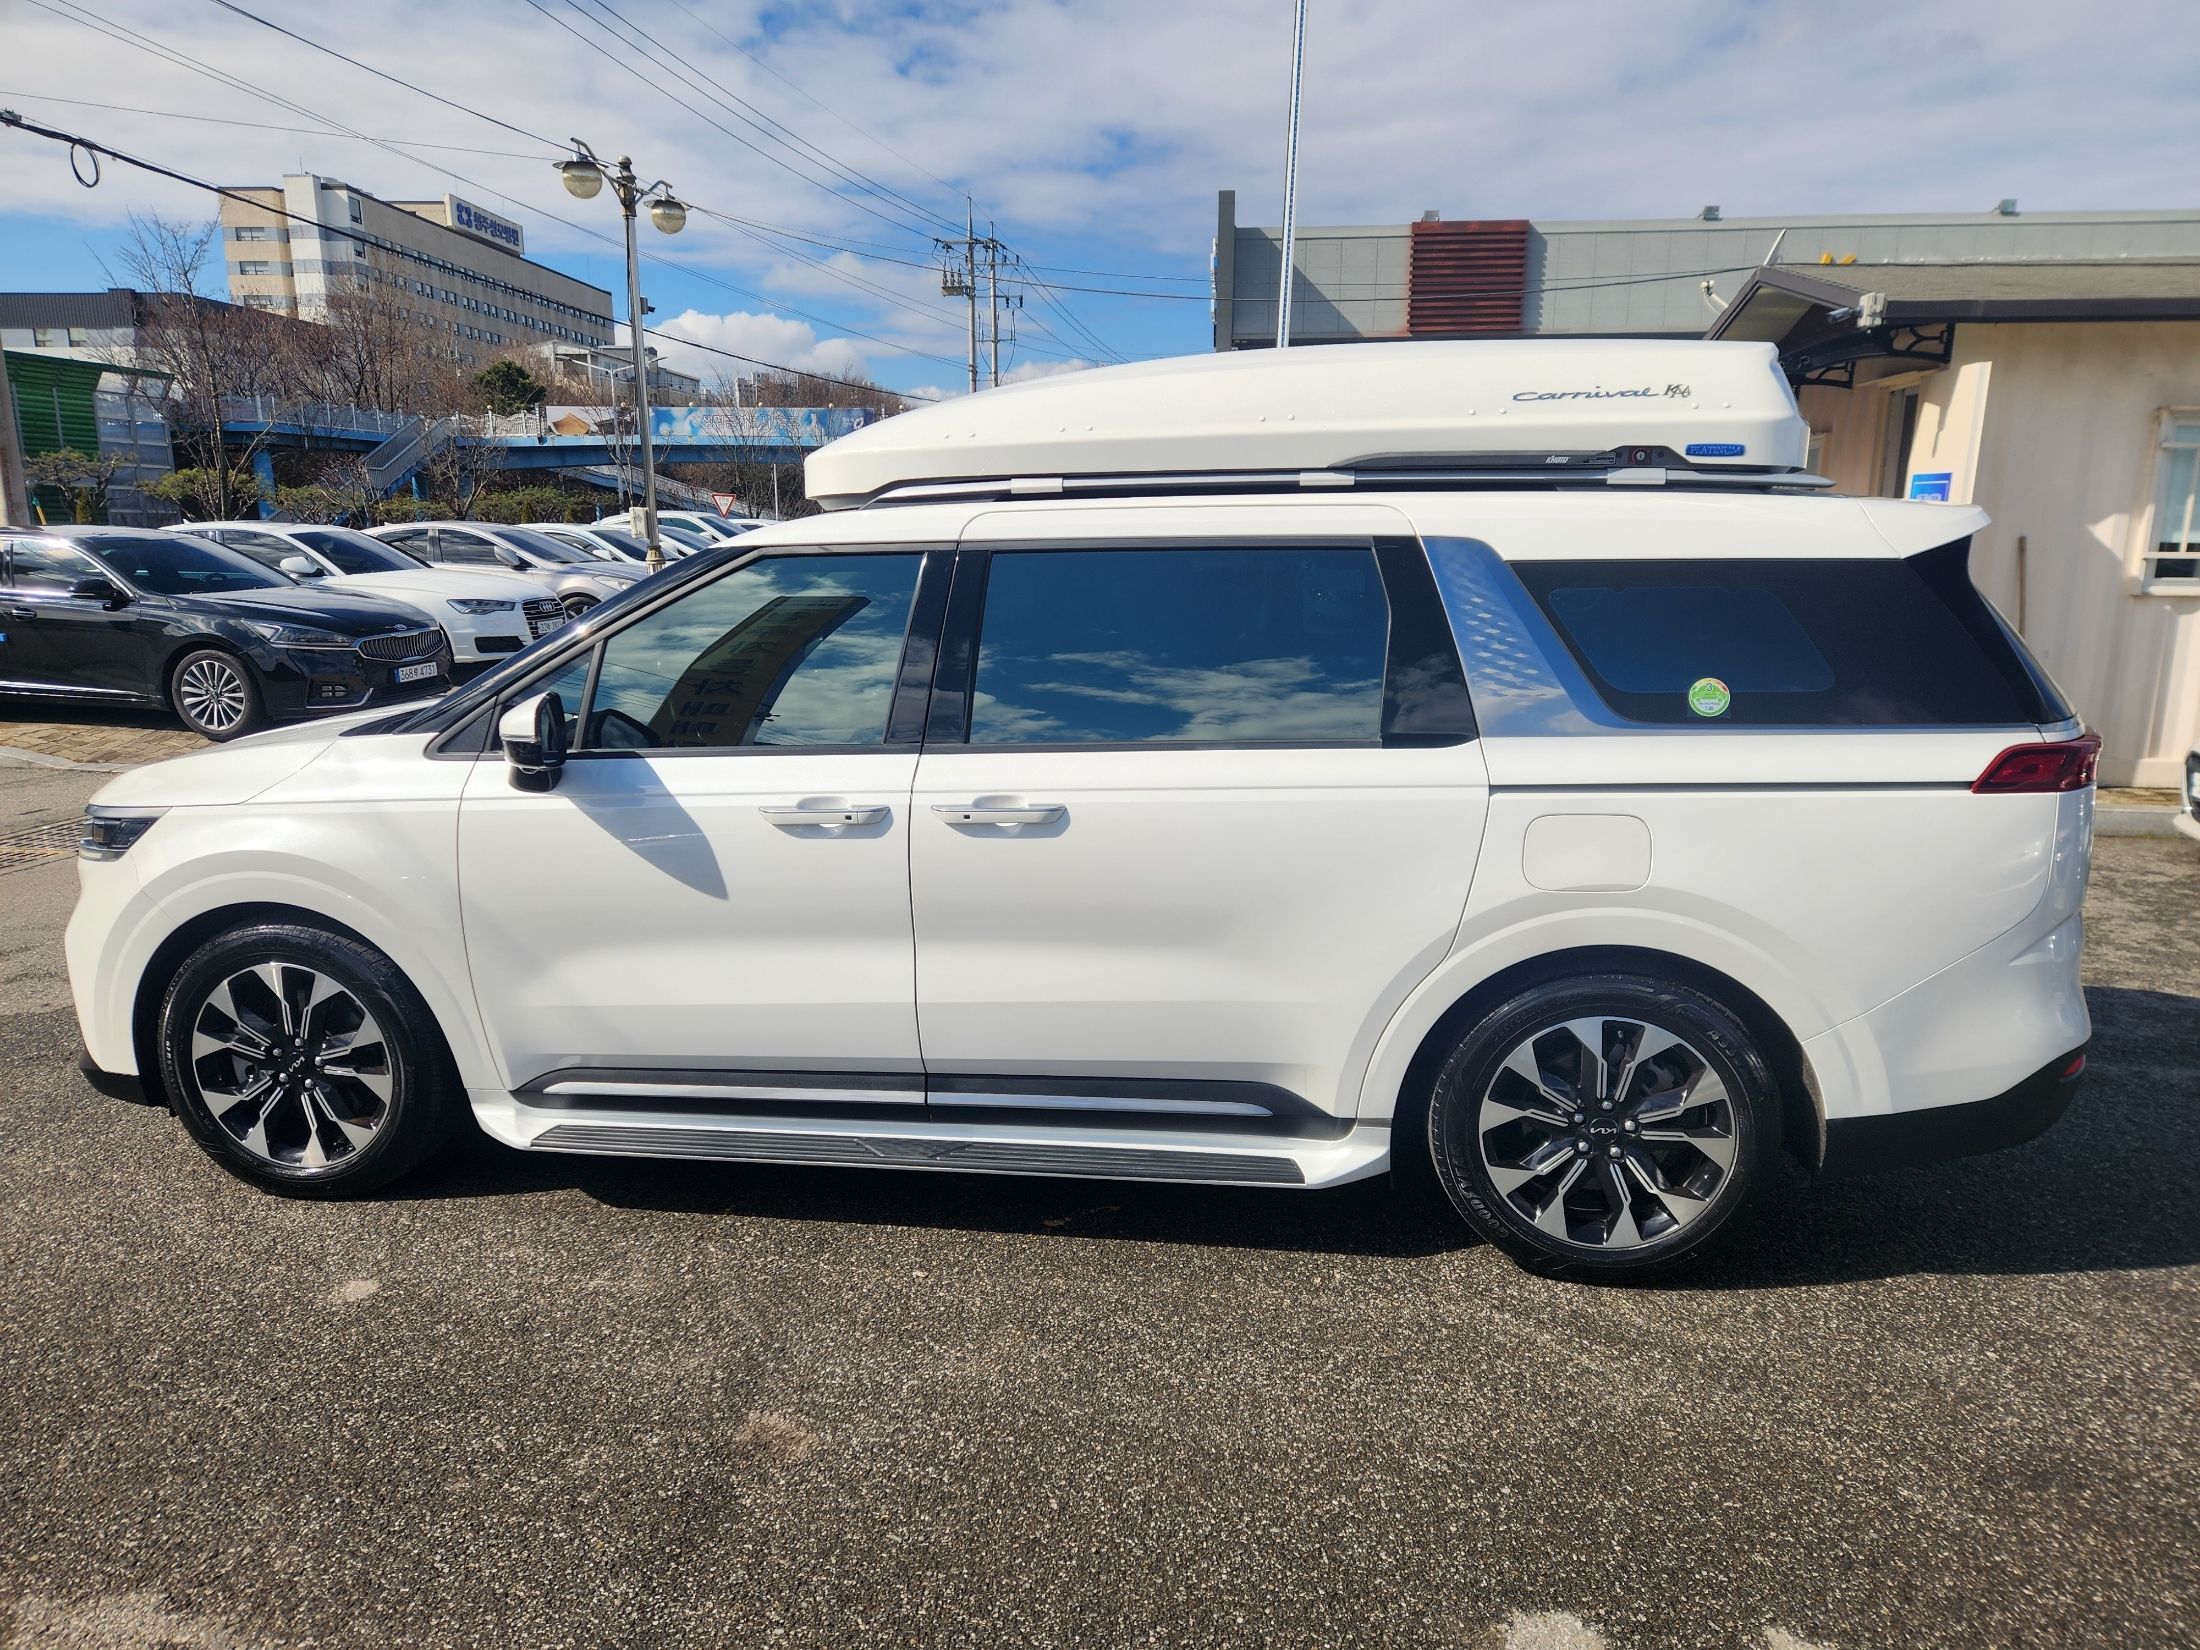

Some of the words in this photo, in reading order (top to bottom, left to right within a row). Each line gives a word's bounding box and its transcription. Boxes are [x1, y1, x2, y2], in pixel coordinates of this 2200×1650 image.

[1512, 386, 1659, 401] Carnival
[1690, 446, 1742, 455] PLATINUM
[1706, 682, 1713, 692] 3
